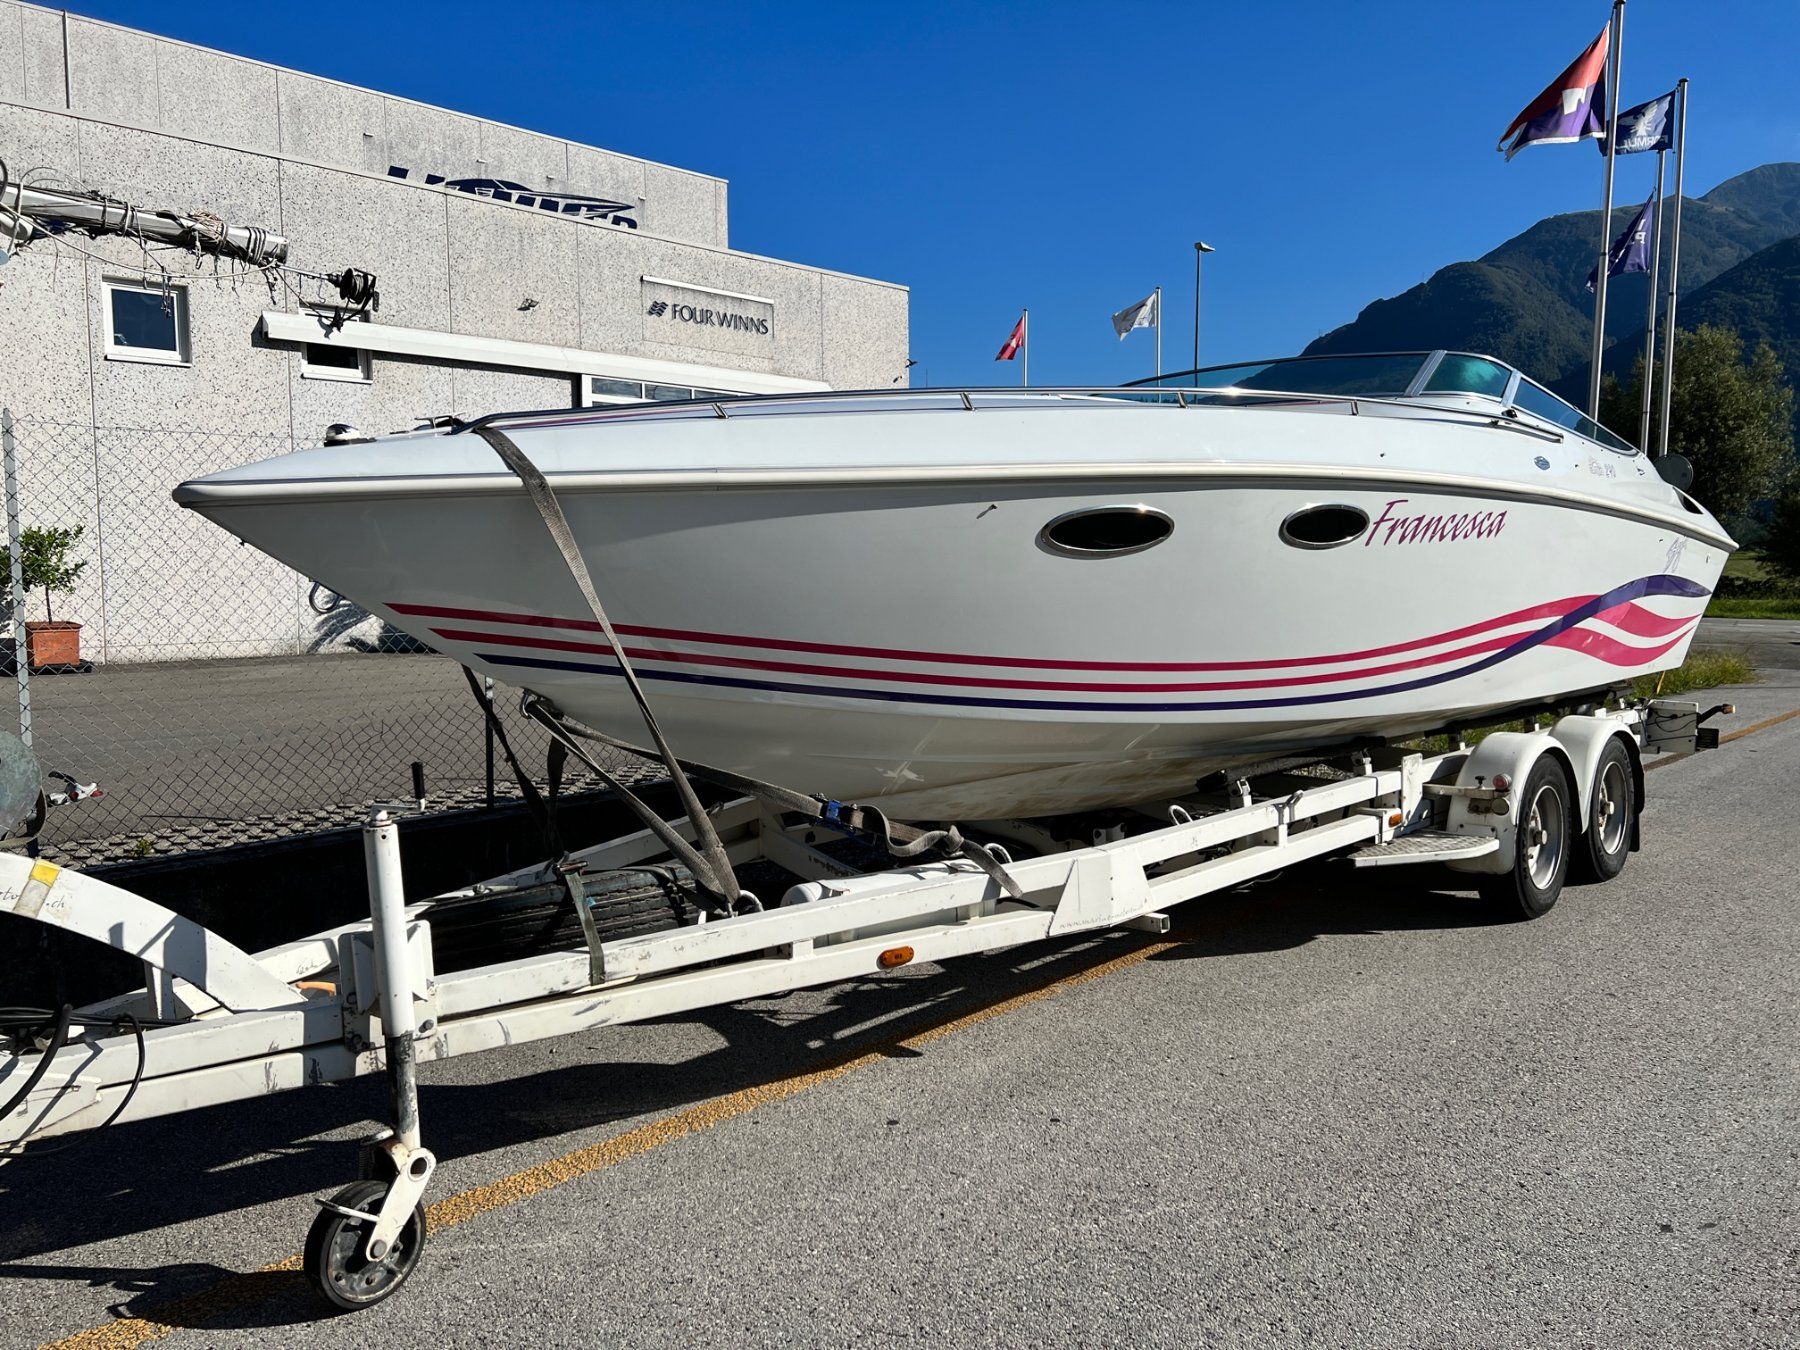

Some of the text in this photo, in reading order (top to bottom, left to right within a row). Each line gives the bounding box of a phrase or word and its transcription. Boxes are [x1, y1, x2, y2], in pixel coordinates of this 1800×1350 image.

[671, 303, 769, 335] FOUR WINNS
[1364, 499, 1508, 547] Francesca
